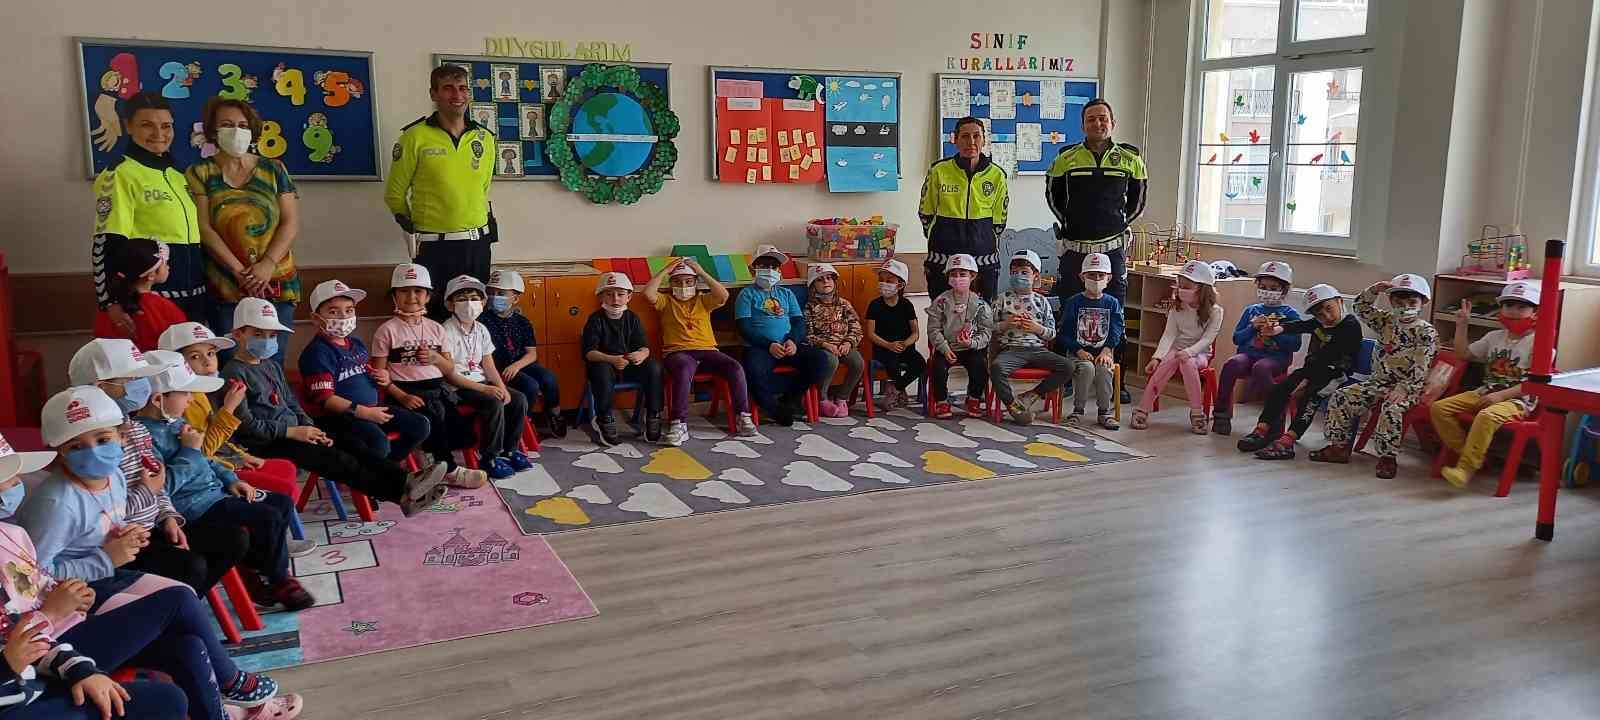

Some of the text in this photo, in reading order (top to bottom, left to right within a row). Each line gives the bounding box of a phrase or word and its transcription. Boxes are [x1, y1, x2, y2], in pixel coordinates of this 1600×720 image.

[969, 32, 1028, 49] SINIF
[946, 56, 1074, 72] KURALLARIMIZ
[158, 61, 190, 99] 2
[217, 63, 249, 102] 3
[275, 68, 306, 106] 4
[322, 70, 352, 107] 5
[257, 120, 334, 162] 8 9
[320, 550, 347, 566] 3
